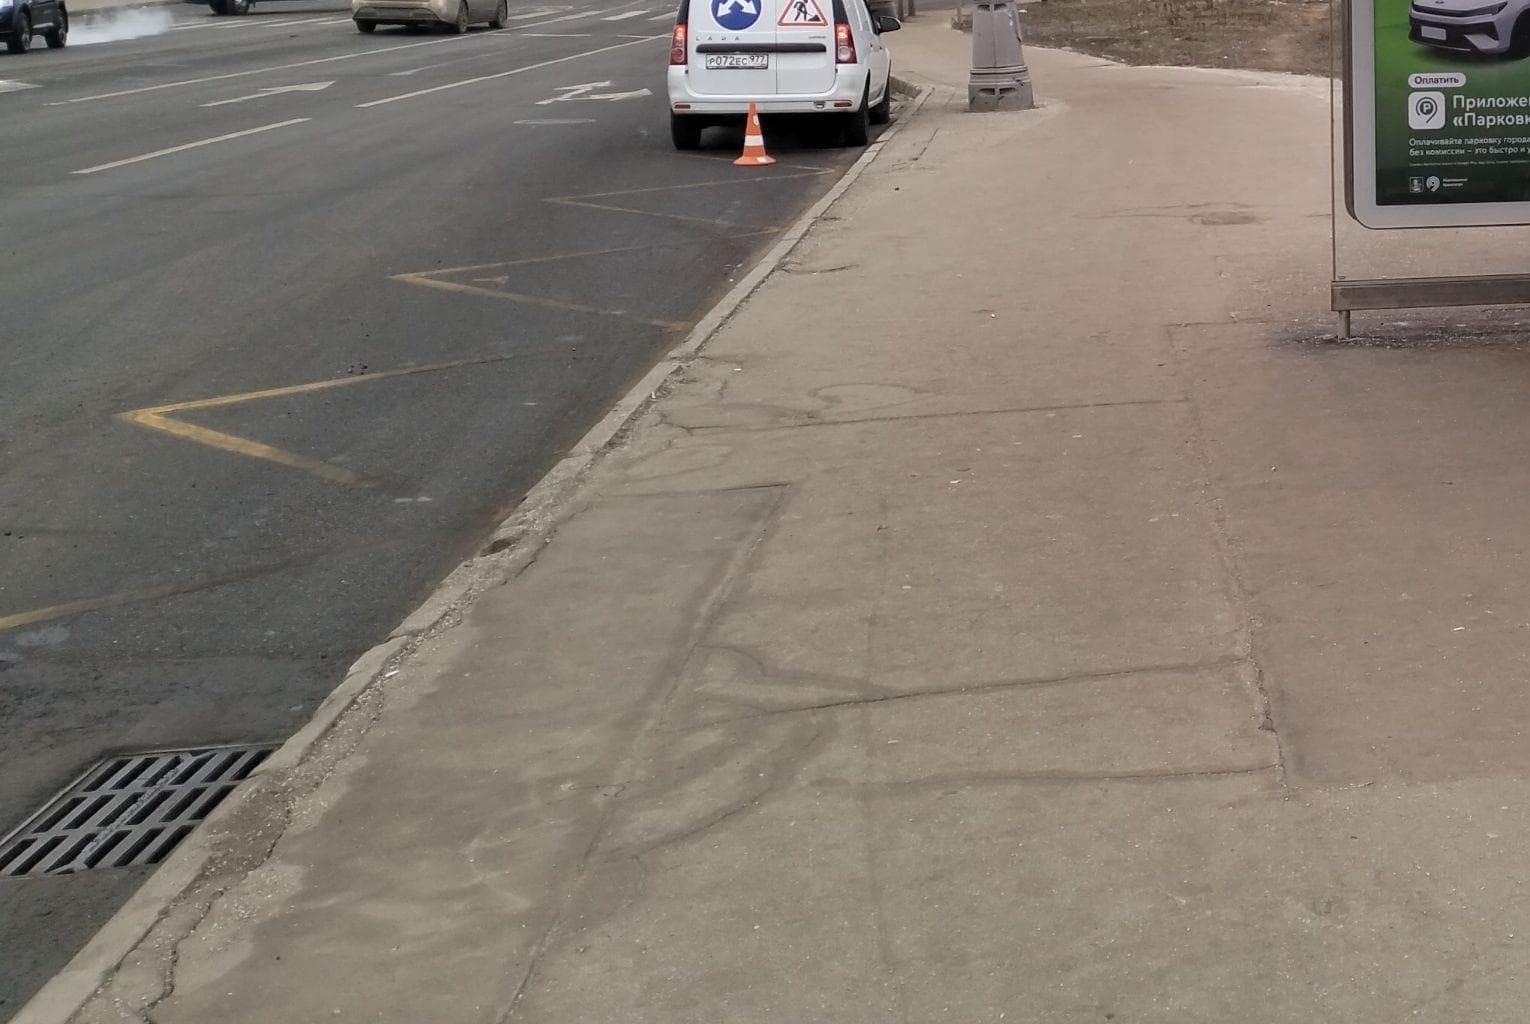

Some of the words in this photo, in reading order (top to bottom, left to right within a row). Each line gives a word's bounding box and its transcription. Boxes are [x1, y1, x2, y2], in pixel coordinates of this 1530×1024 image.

[1414, 76, 1460, 85] Оплатить
[1408, 137, 1463, 147] Оплачивайте
[1464, 138, 1502, 146] парковку
[1503, 136, 1530, 145] города
[1409, 147, 1424, 157] без
[1488, 145, 1518, 154] быстро
